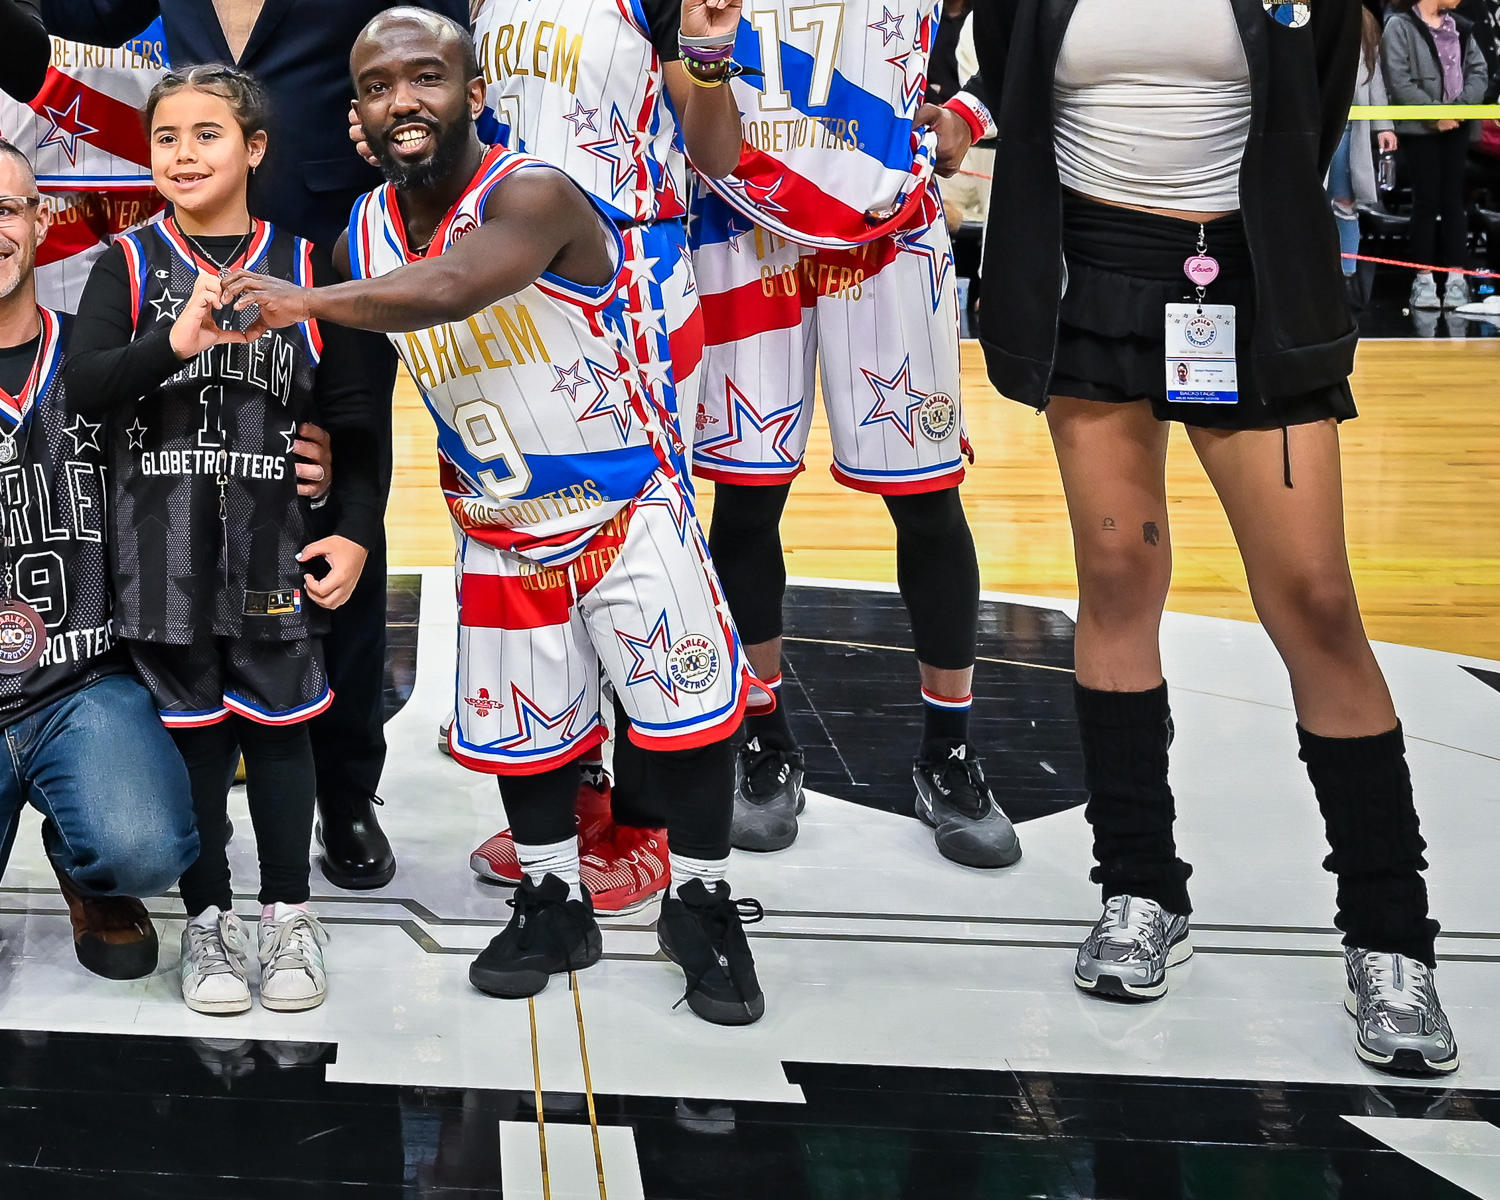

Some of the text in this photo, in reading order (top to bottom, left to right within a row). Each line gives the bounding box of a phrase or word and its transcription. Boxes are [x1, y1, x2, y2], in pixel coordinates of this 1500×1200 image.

[475, 20, 584, 94] ARLEM
[751, 3, 845, 112] 17
[924, 395, 950, 410] HARLEM
[141, 449, 286, 480] GLOBETROTTERS
[453, 398, 534, 502] 9
[15, 550, 68, 628] 9
[670, 655, 718, 690] GLOBETROTTERS
[674, 638, 709, 656] HARLEM
